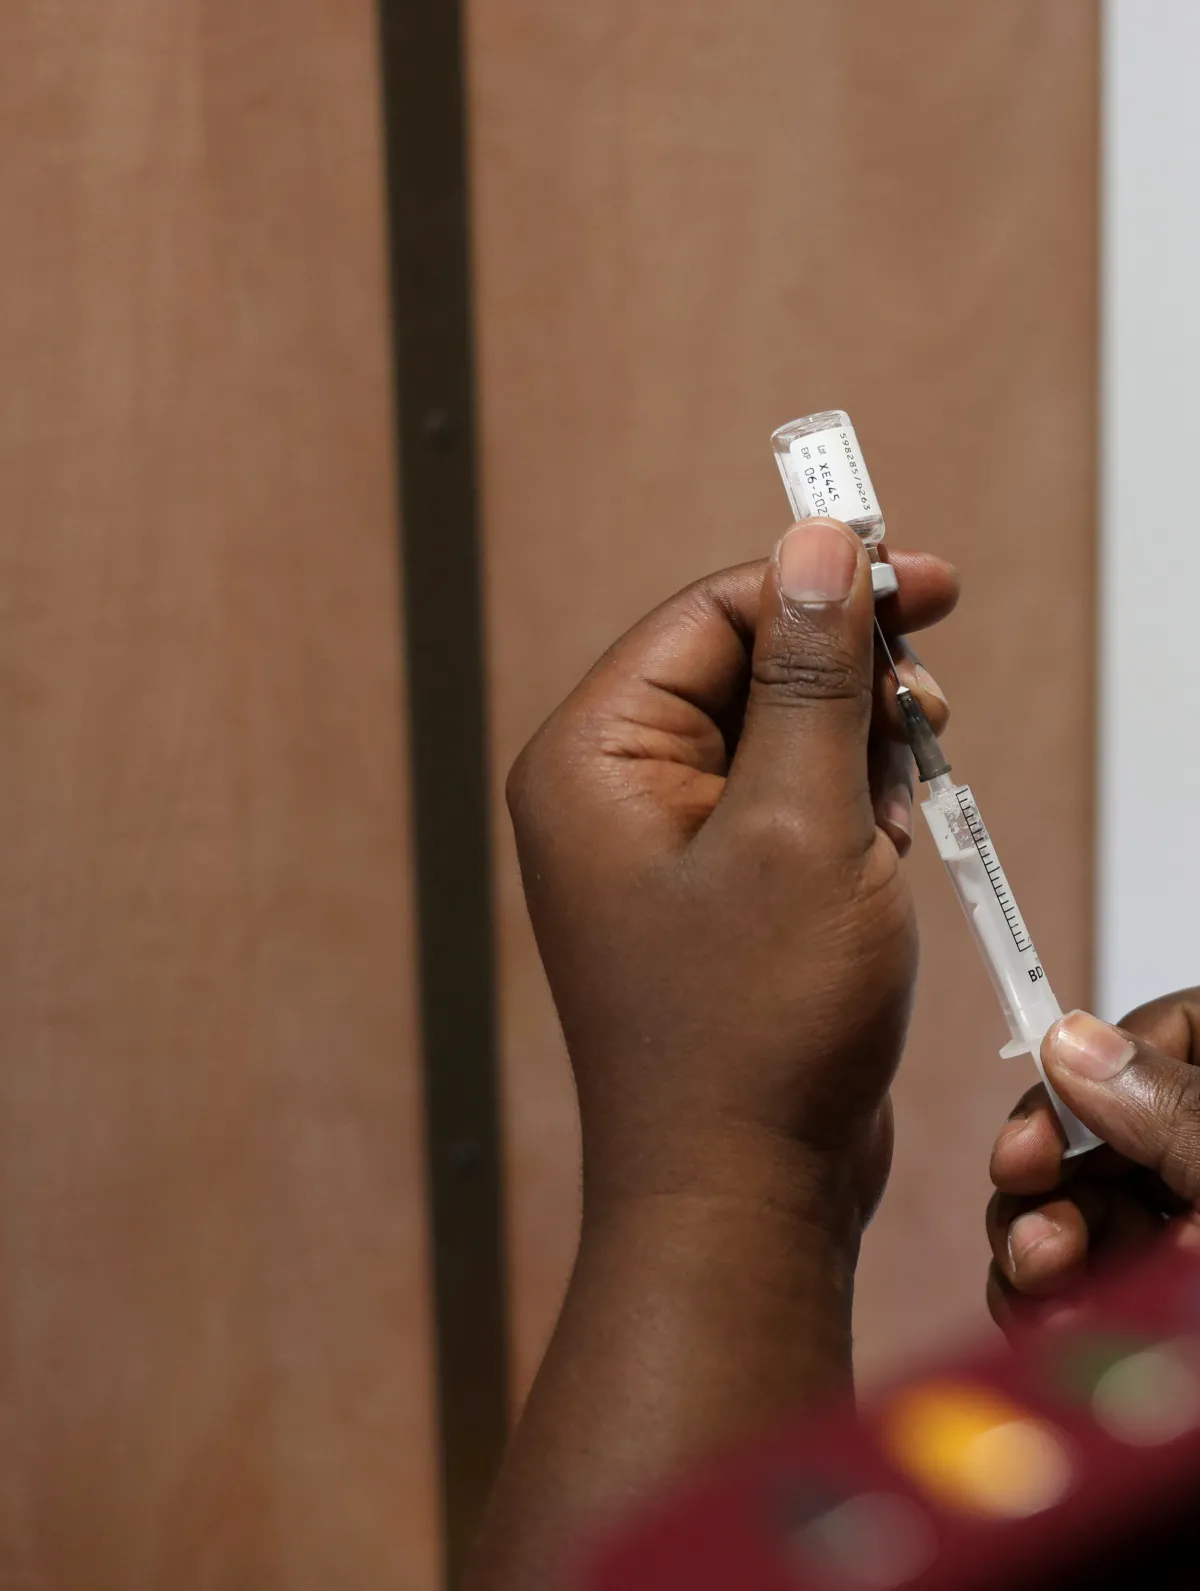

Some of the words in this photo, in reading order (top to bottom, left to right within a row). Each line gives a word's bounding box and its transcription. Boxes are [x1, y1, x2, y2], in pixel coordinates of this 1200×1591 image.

[801, 447, 811, 459] EXP
[804, 467, 829, 517] 06-202
[818, 462, 840, 502] XE445
[1028, 966, 1044, 982] BD
